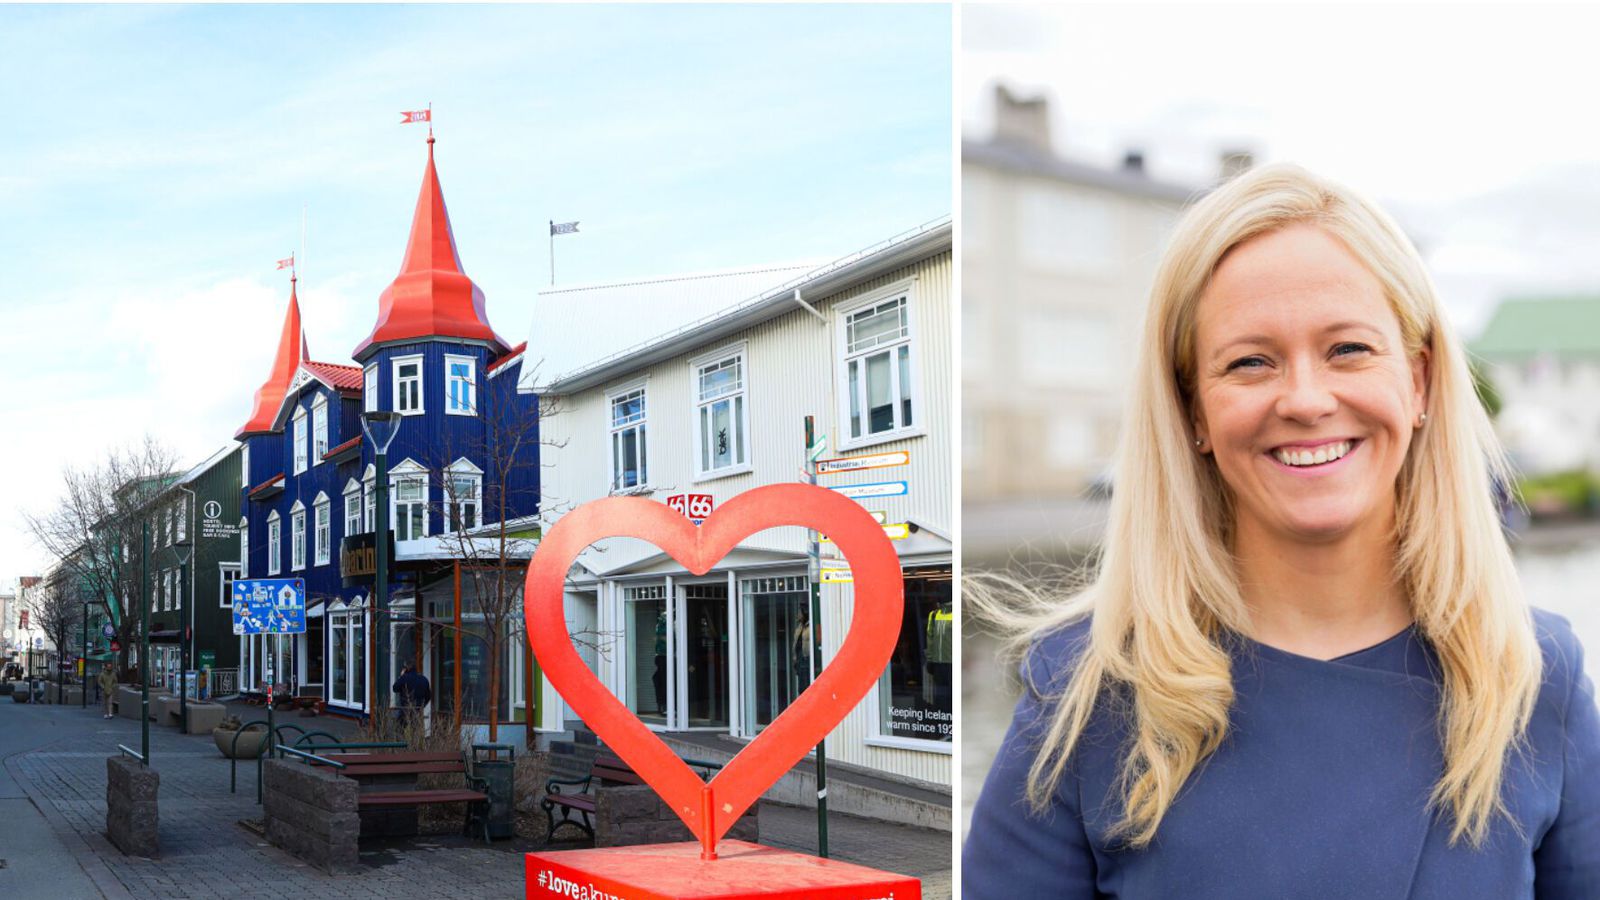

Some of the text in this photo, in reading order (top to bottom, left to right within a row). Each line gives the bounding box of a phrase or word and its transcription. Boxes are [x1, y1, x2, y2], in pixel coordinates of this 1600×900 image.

[341, 541, 388, 577] barin
[888, 706, 953, 721] Keeping Icelan
[887, 720, 953, 735] warm since 192
